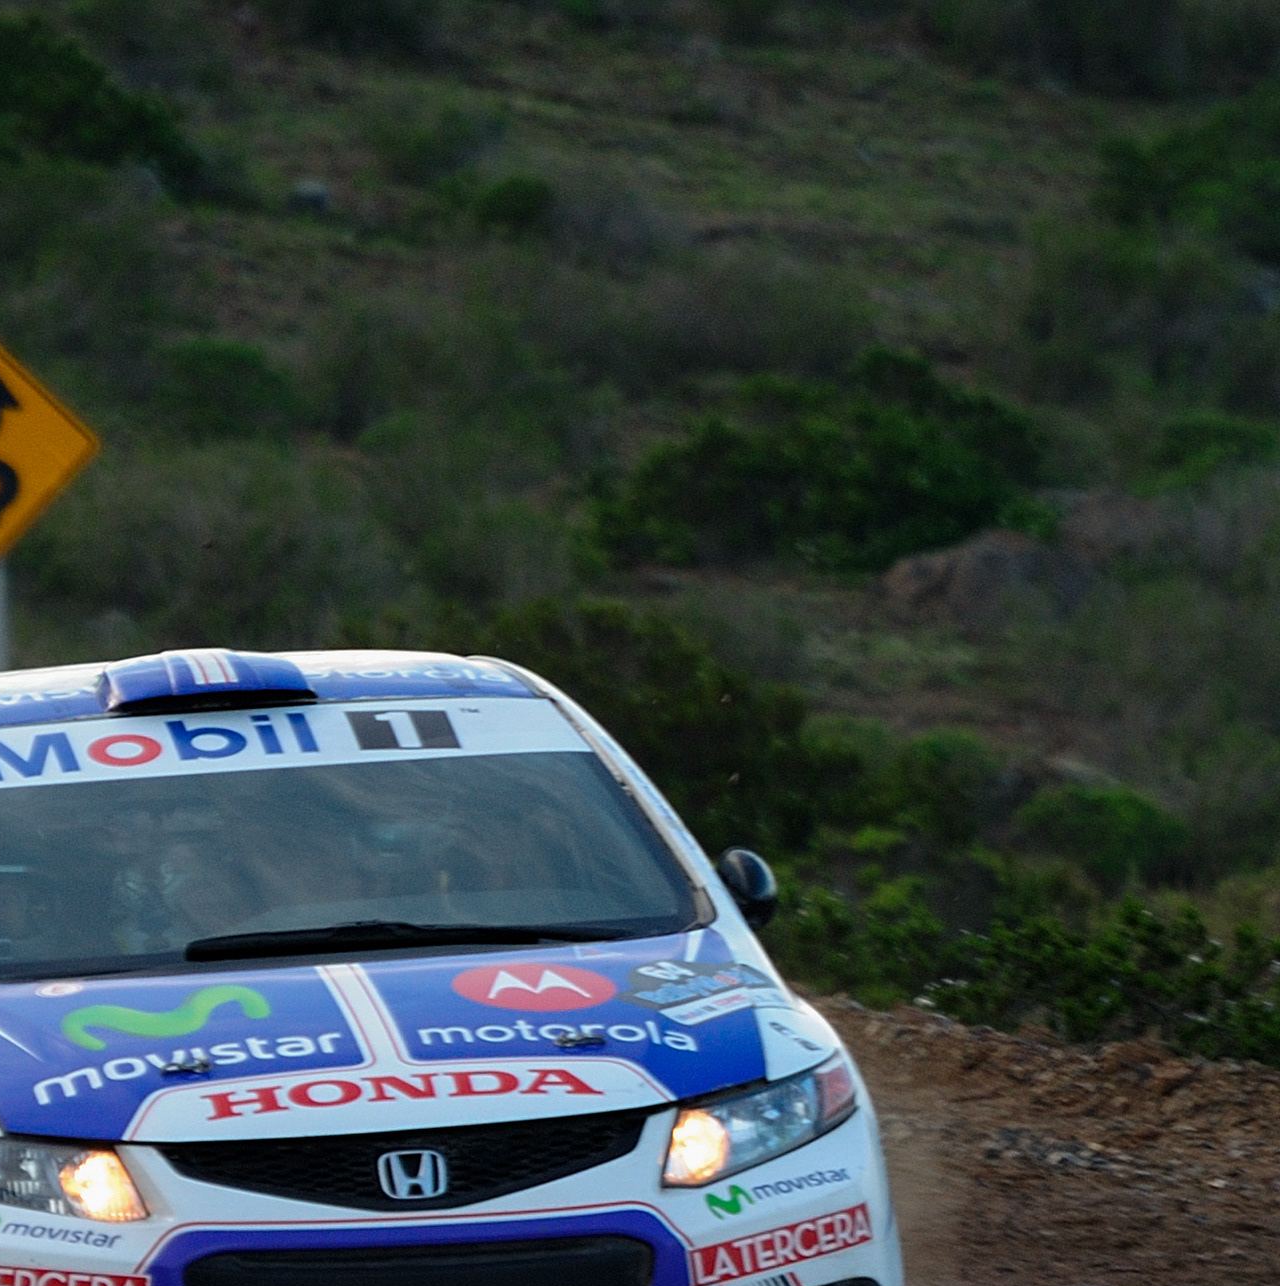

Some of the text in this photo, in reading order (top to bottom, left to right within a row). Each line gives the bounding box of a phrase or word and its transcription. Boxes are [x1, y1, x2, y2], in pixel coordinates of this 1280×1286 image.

[419, 1019, 699, 1053] motorola
[33, 1032, 343, 1106] movistar
[204, 1068, 604, 1122] HONDA
[751, 1166, 851, 1201] movistar
[1, 1220, 123, 1249] movistar
